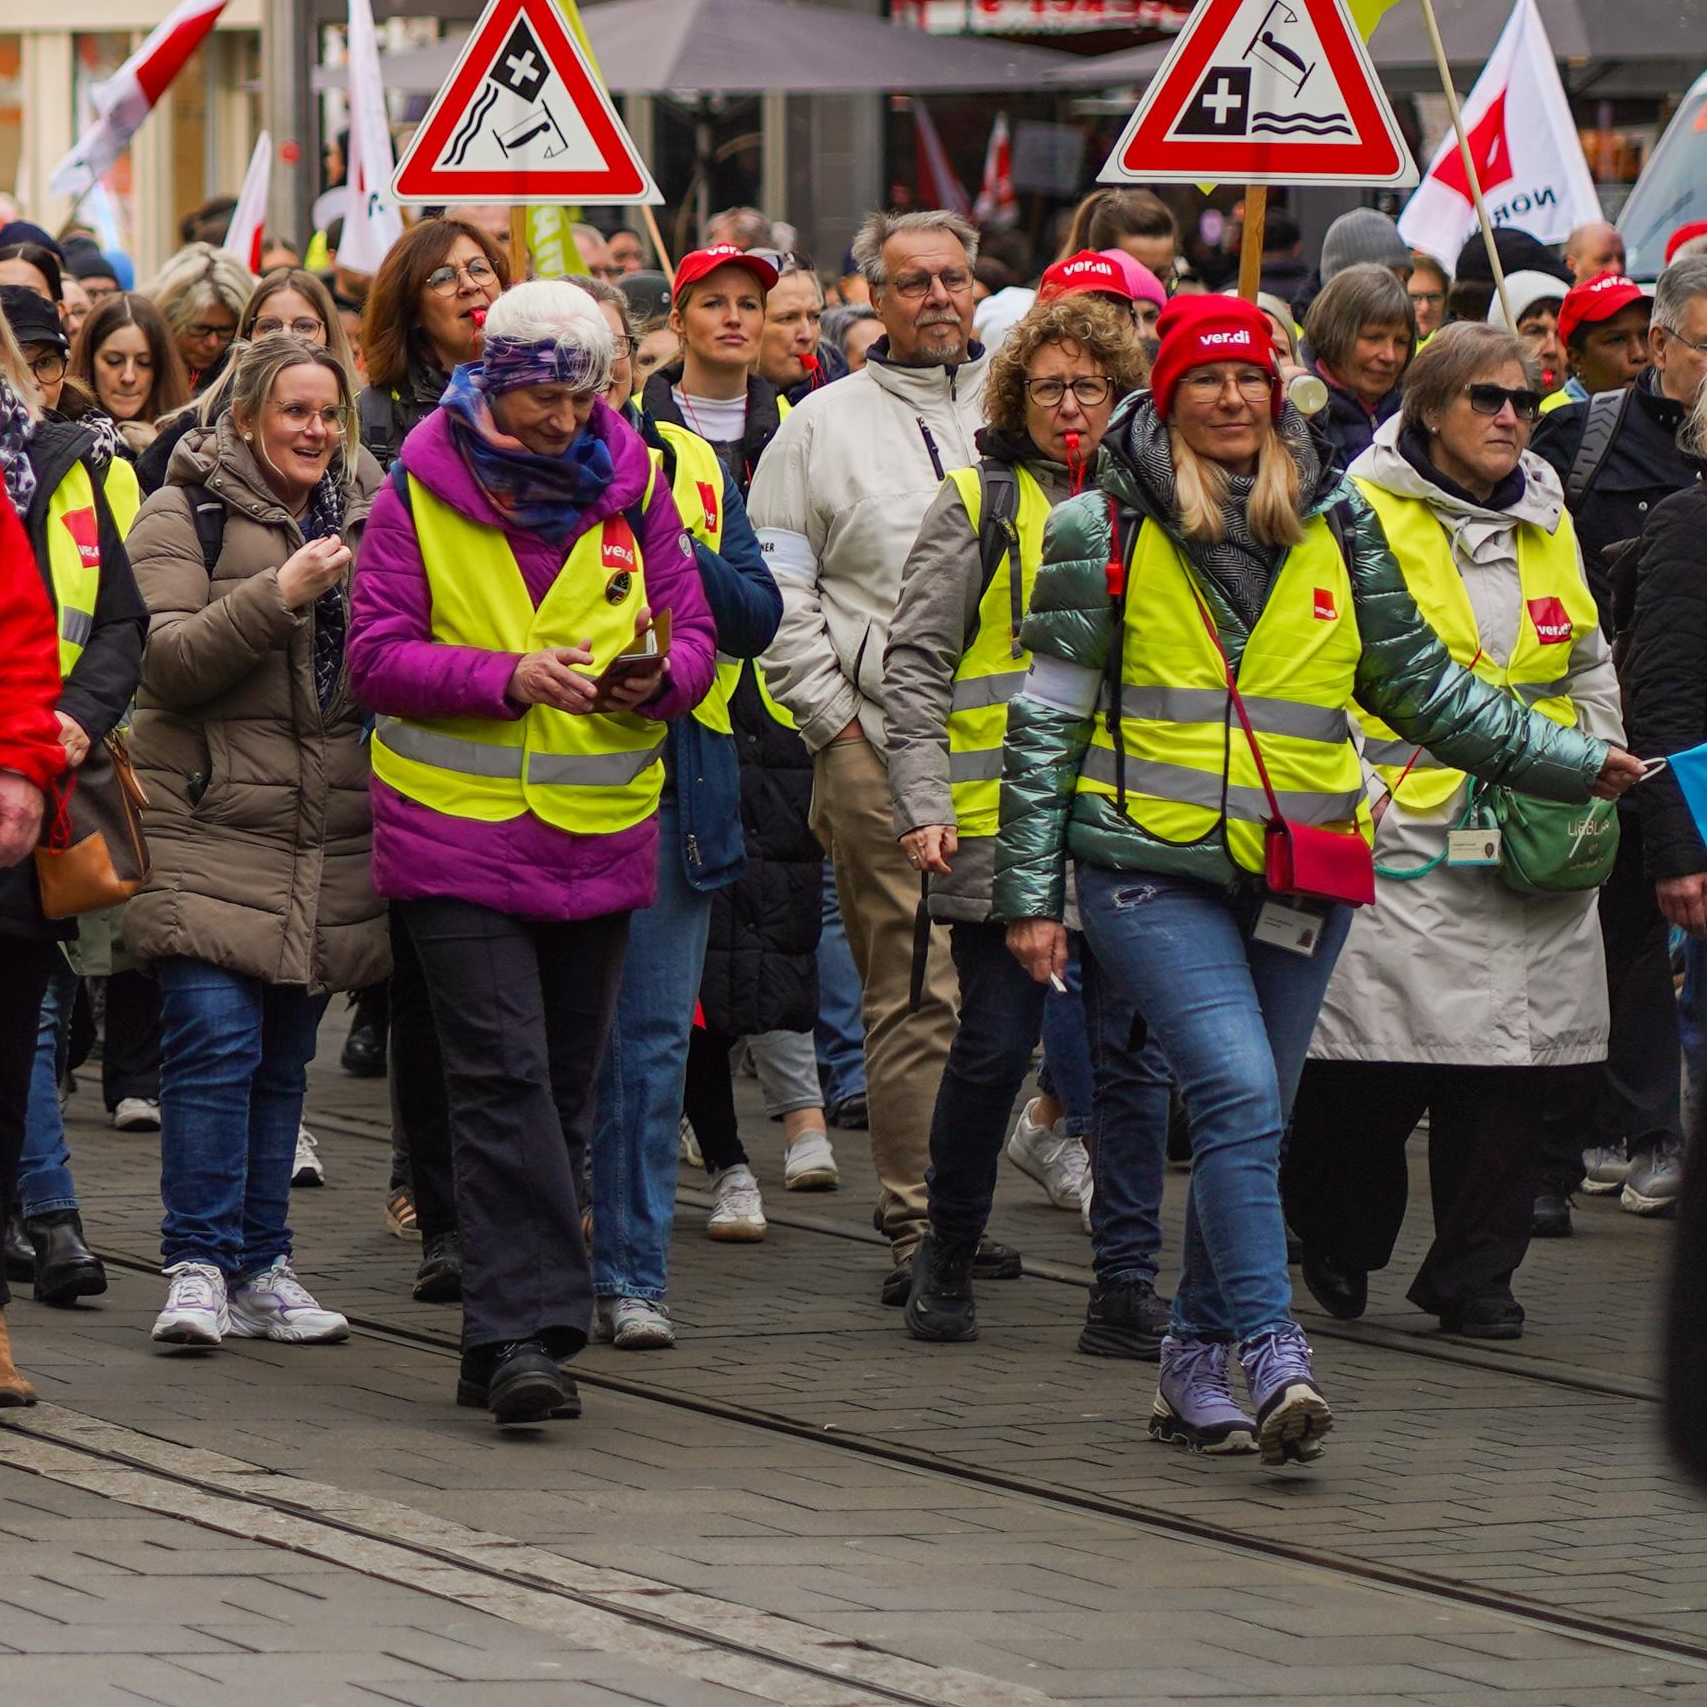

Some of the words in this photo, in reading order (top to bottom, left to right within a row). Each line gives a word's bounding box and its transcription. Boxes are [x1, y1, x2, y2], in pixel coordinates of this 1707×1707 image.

[1063, 260, 1112, 276] ver.di
[1199, 329, 1251, 346] ver.di
[760, 542, 775, 553] NER
